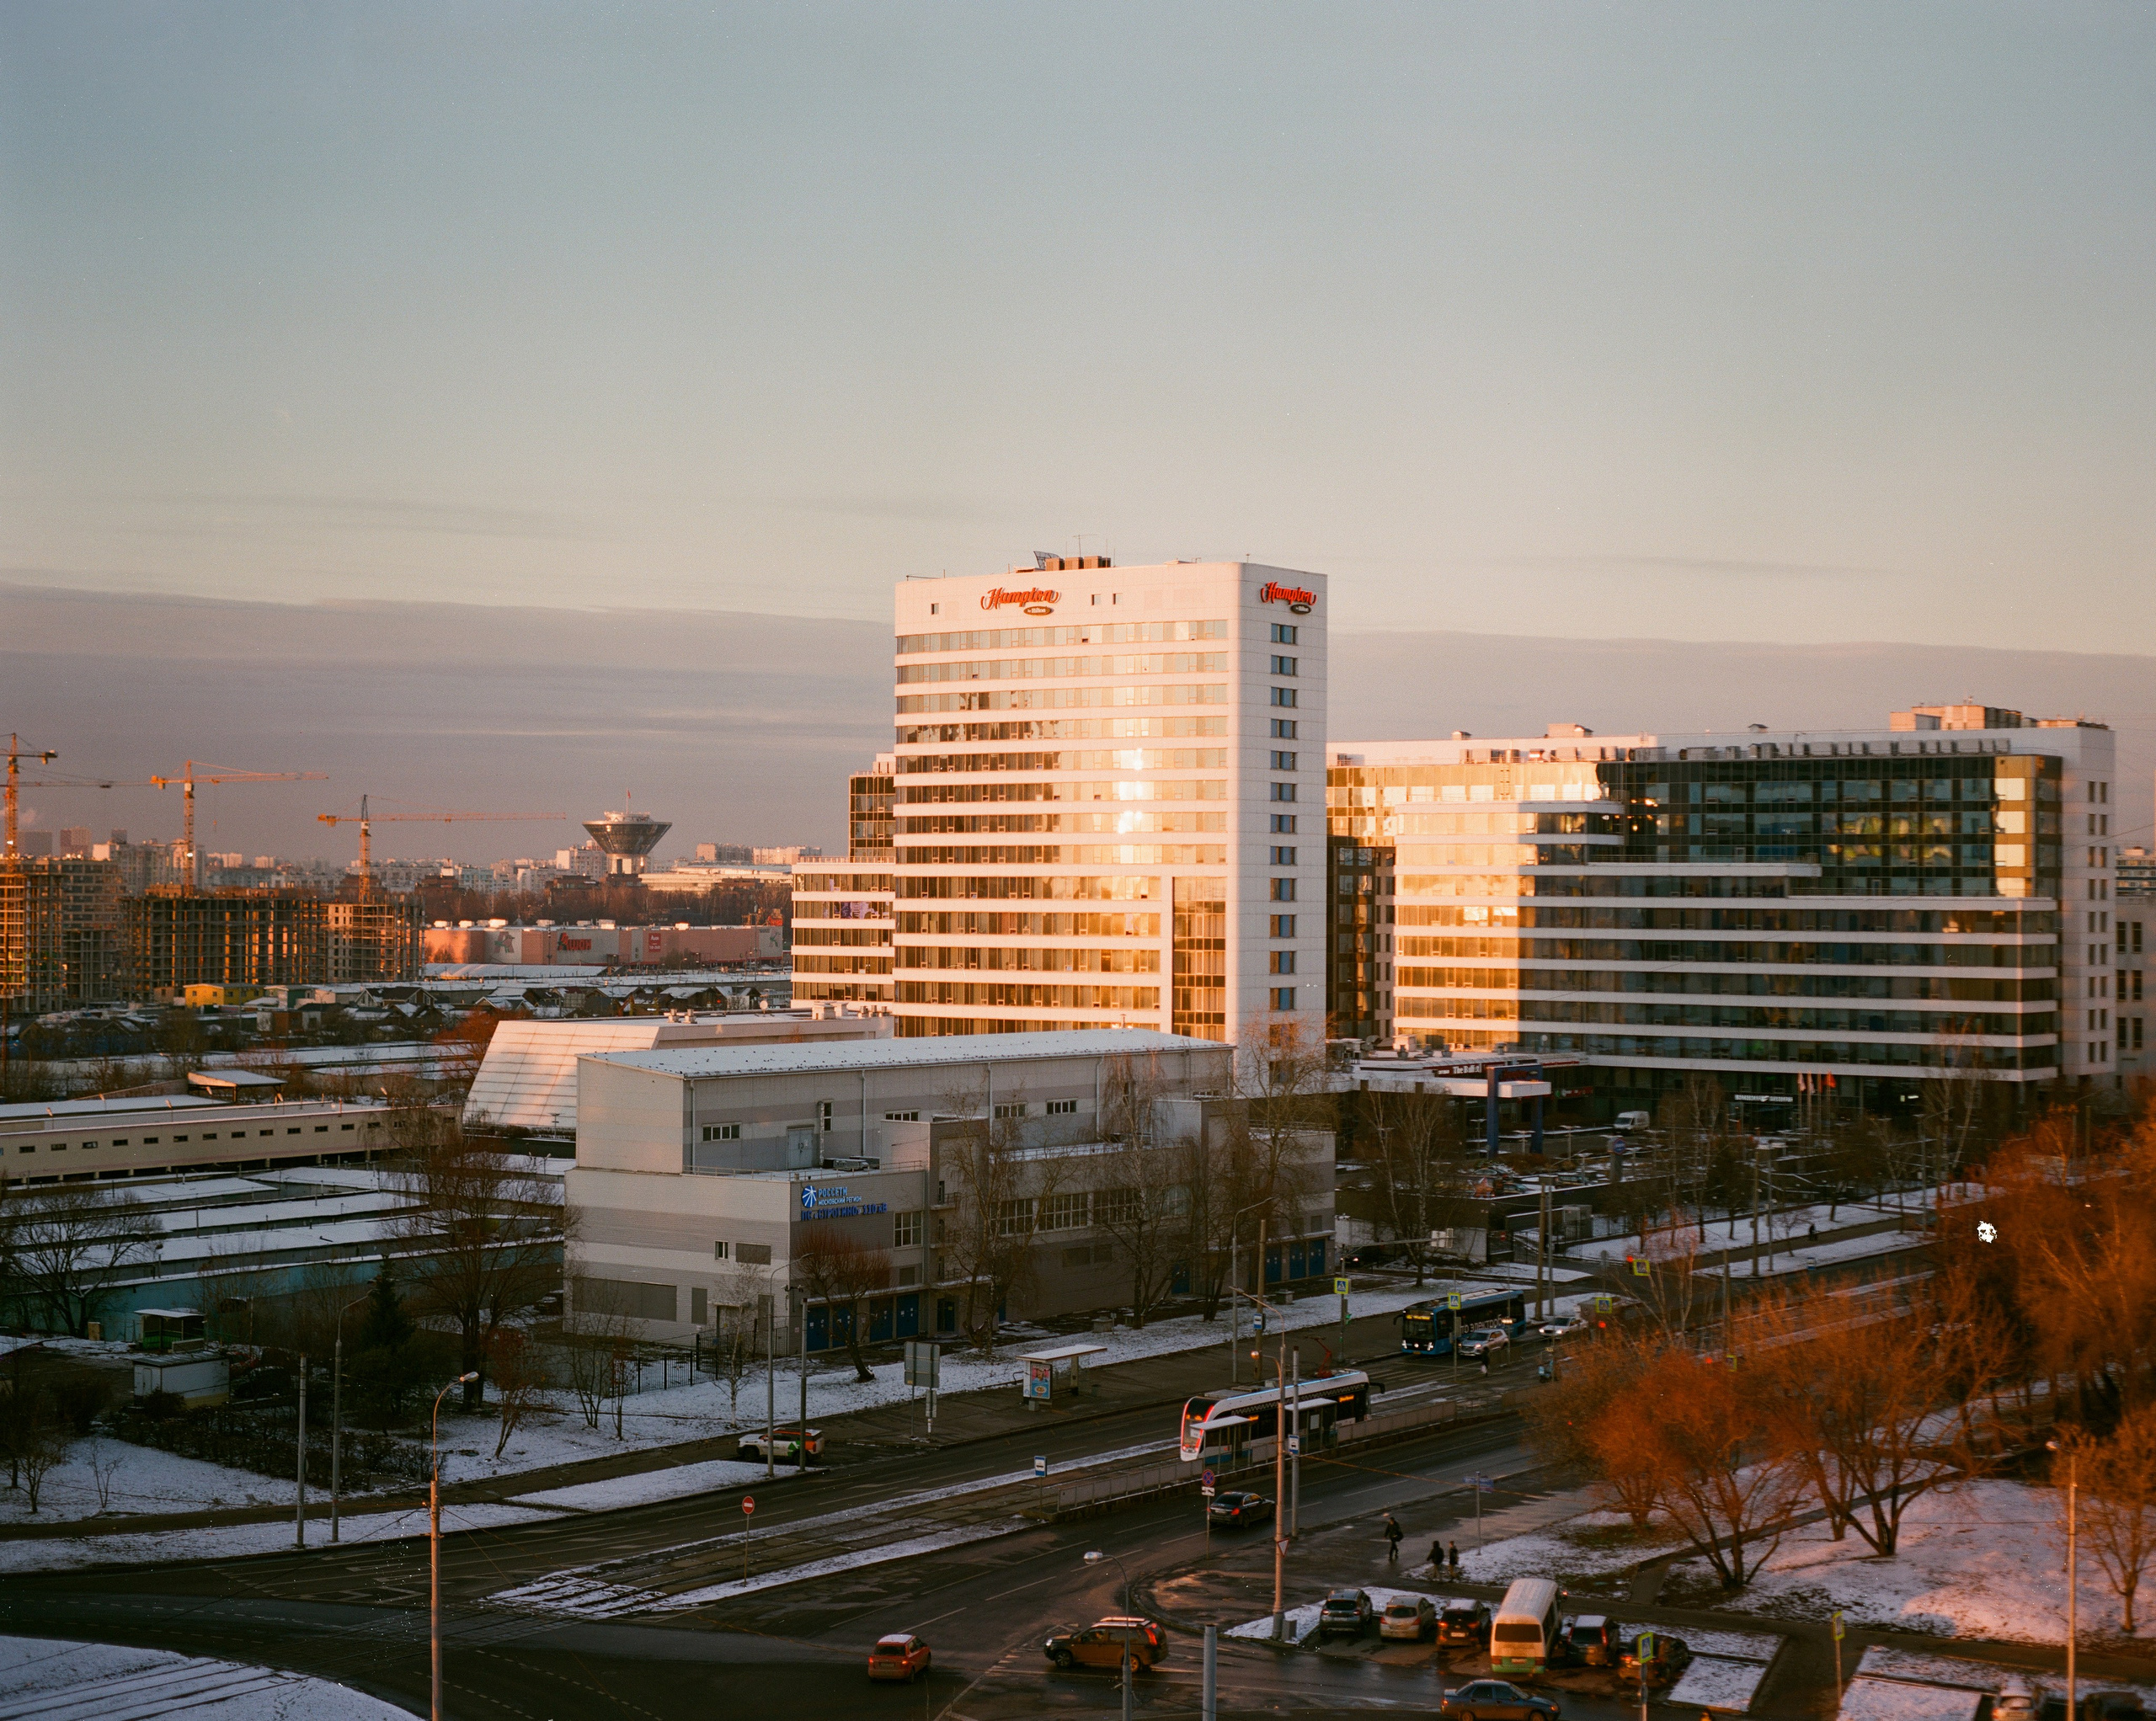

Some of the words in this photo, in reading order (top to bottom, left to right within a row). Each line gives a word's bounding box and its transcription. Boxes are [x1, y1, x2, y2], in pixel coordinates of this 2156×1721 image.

[980, 587, 1059, 610] Hampton
[1261, 581, 1317, 605] Hampton
[1453, 1066, 1464, 1074] The
[818, 1186, 847, 1198] РОССЕТИ
[818, 1196, 846, 1207] МОСКОВСКИЙ
[846, 1196, 862, 1204] РЕГИОН
[801, 1210, 813, 1222] ПС
[863, 1203, 877, 1215] 110
[1470, 1313, 1510, 1332] электроб
